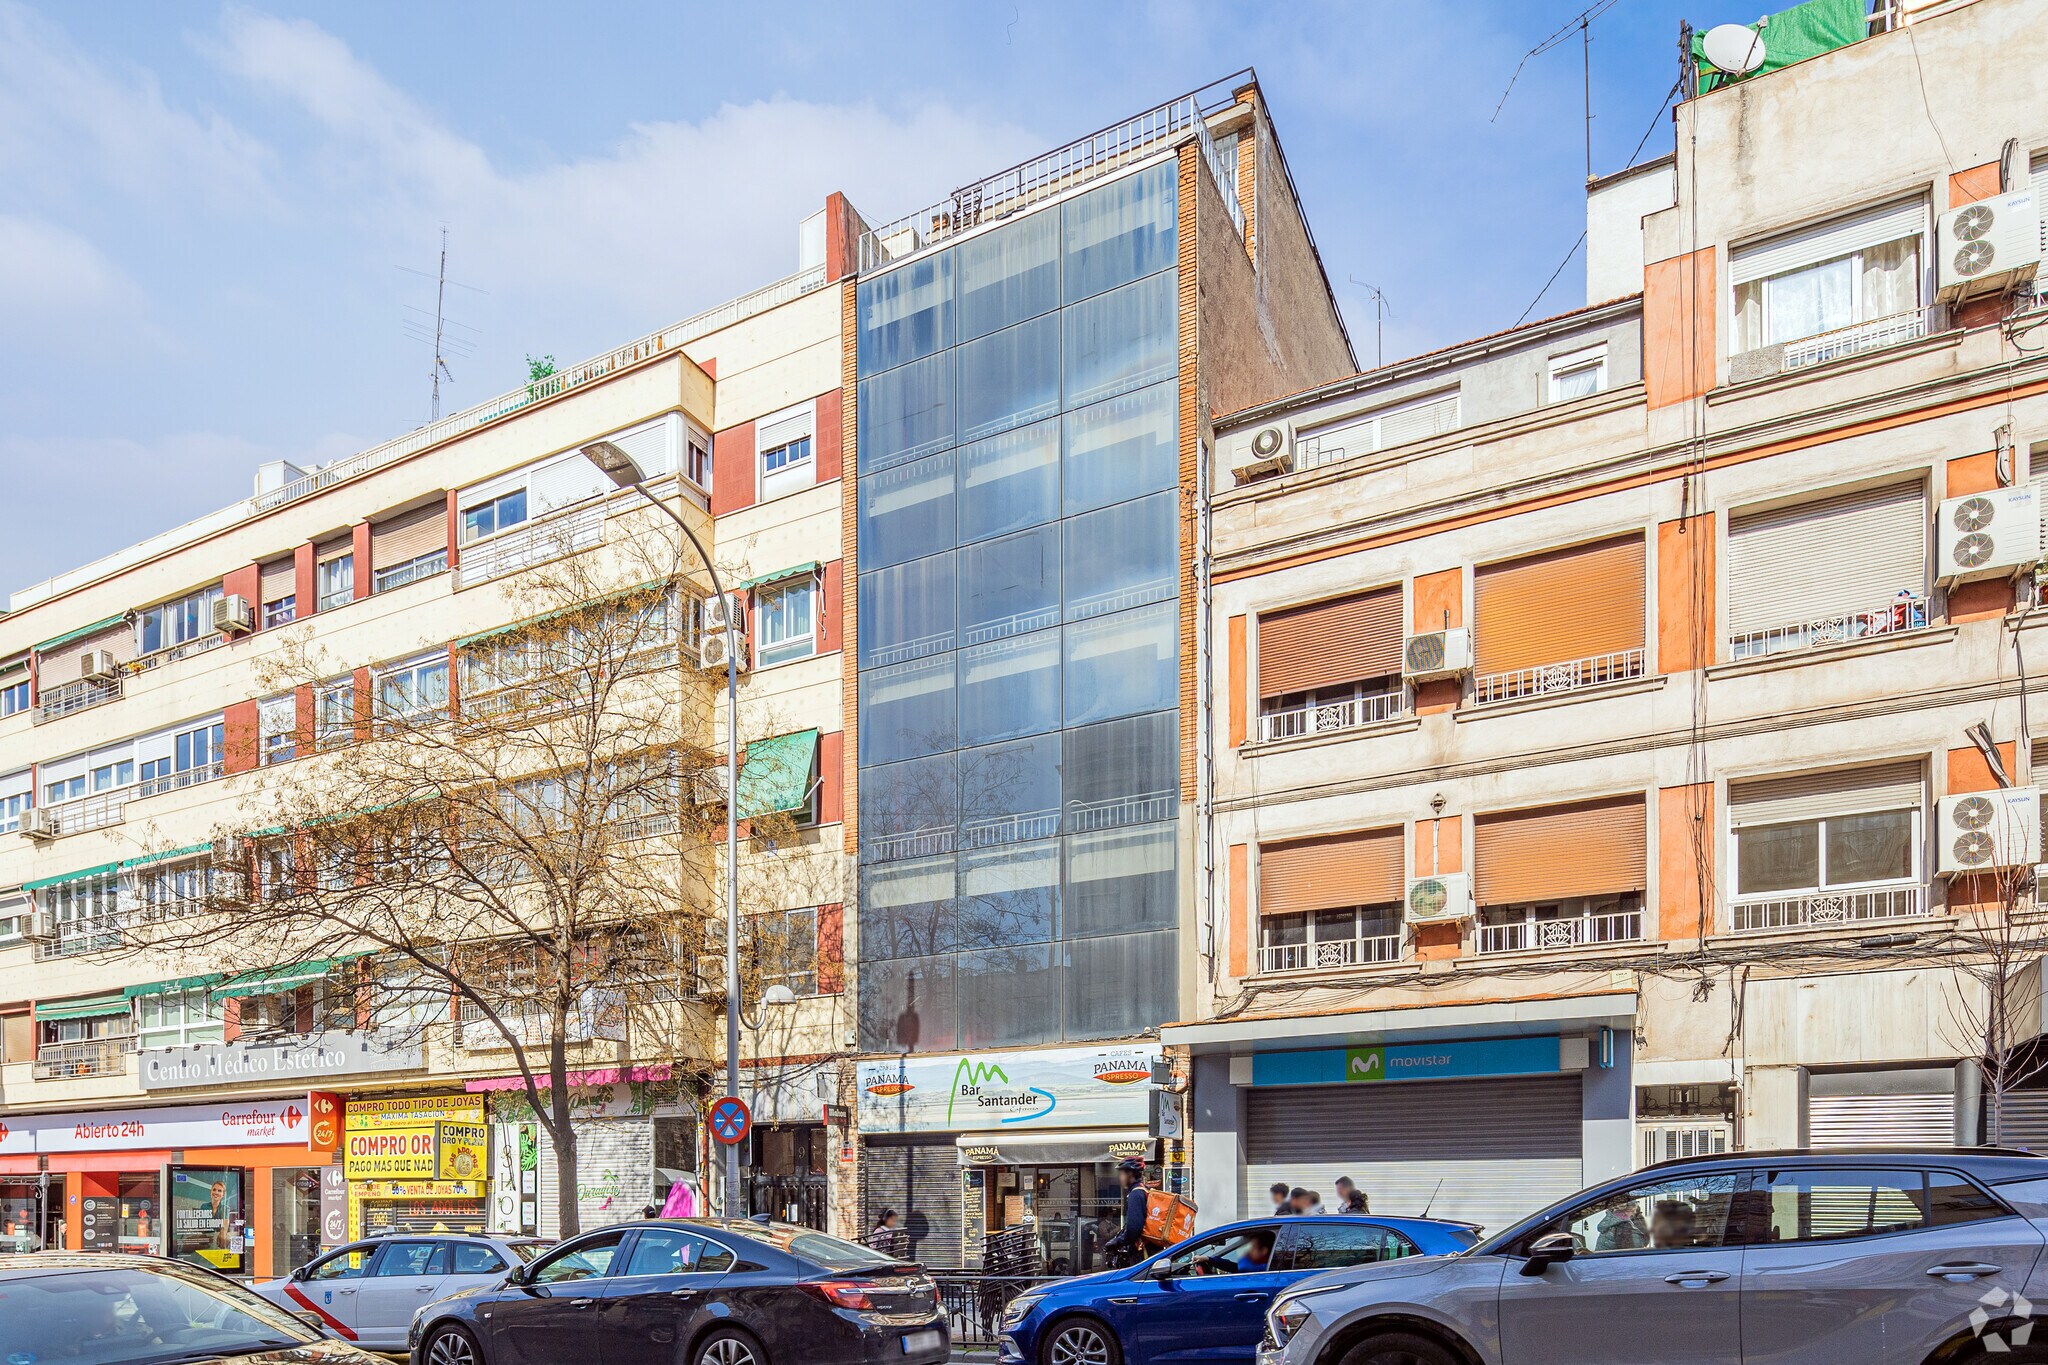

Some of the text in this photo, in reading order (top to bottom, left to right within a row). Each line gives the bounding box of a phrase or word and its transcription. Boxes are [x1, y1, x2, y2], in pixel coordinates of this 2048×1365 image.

[2007, 196, 2031, 207] KAYSUN
[2008, 493, 2032, 503] KAYSUN
[2007, 796, 2031, 804] KAYSUN
[147, 1046, 347, 1082] Centro Médico Estético
[1093, 1060, 1148, 1075] PANAMA
[1390, 1055, 1452, 1068] movistar
[865, 1073, 910, 1087] PANAMA
[1102, 1073, 1139, 1081] ESPRESSO
[872, 1085, 903, 1093] ESPRESSO
[961, 1085, 981, 1096] Bar
[977, 1093, 1038, 1107] Santander
[1677, 1090, 1691, 1103] 11
[347, 1096, 481, 1113] COMPRO TODO TIPO DE JOYAS
[222, 1109, 276, 1127] Carrefour
[75, 1120, 145, 1140] Abierto 24h
[246, 1125, 276, 1138] market
[317, 1129, 333, 1138] 24/7
[442, 1125, 485, 1139] COMPRO
[351, 1134, 434, 1156] COMPRO OR
[442, 1136, 485, 1147] ORO Y PLATA
[349, 1159, 433, 1173] PAGO MAS QUE NAD
[407, 1185, 425, 1196] VENTA
[426, 1186, 434, 1195] DE
[434, 1184, 453, 1195] JOYAS
[452, 1184, 468, 1195] 70%
[408, 1198, 479, 1216] LOS ADOLFOS
[176, 1219, 183, 1229] LA
[183, 1219, 199, 1229] SALUD
[199, 1219, 206, 1229] EN
[329, 1219, 344, 1229] 24/7
